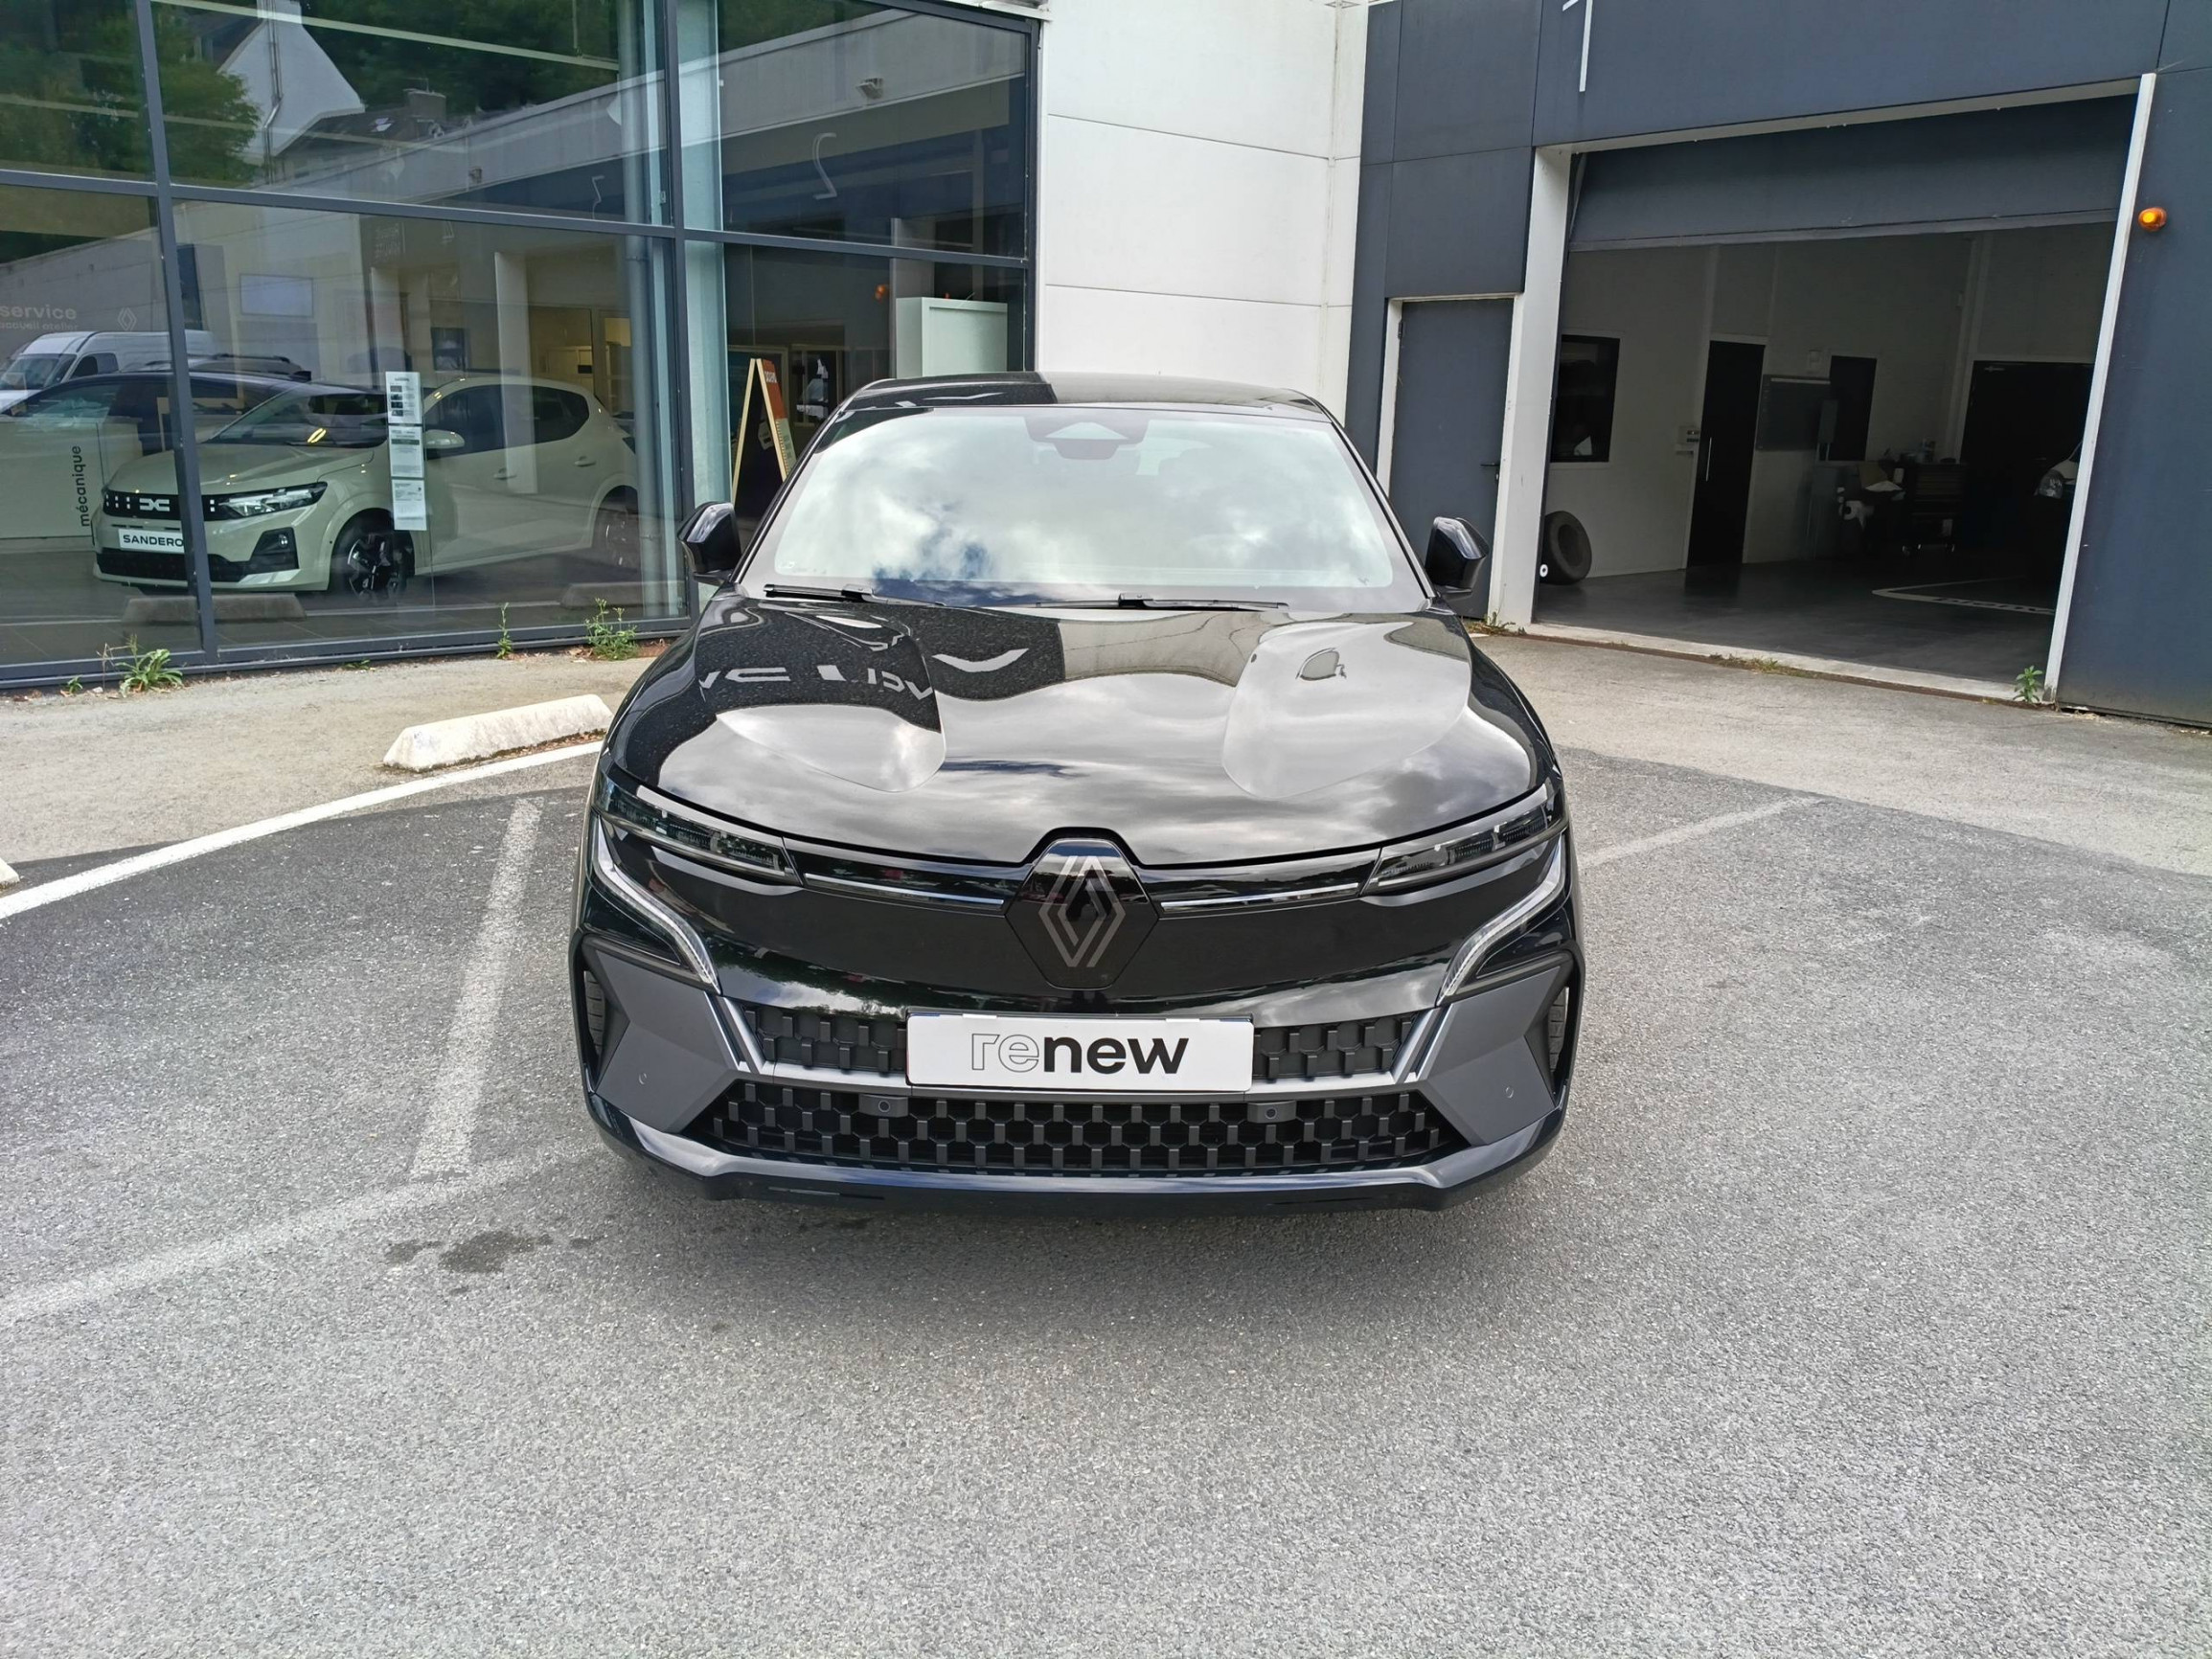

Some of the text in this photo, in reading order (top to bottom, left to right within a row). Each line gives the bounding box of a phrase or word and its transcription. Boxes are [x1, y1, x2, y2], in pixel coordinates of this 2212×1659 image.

[0, 304, 77, 320] service
[72, 445, 91, 527] mécanique
[124, 534, 184, 547] SANDERO
[971, 1033, 1189, 1075] renew
